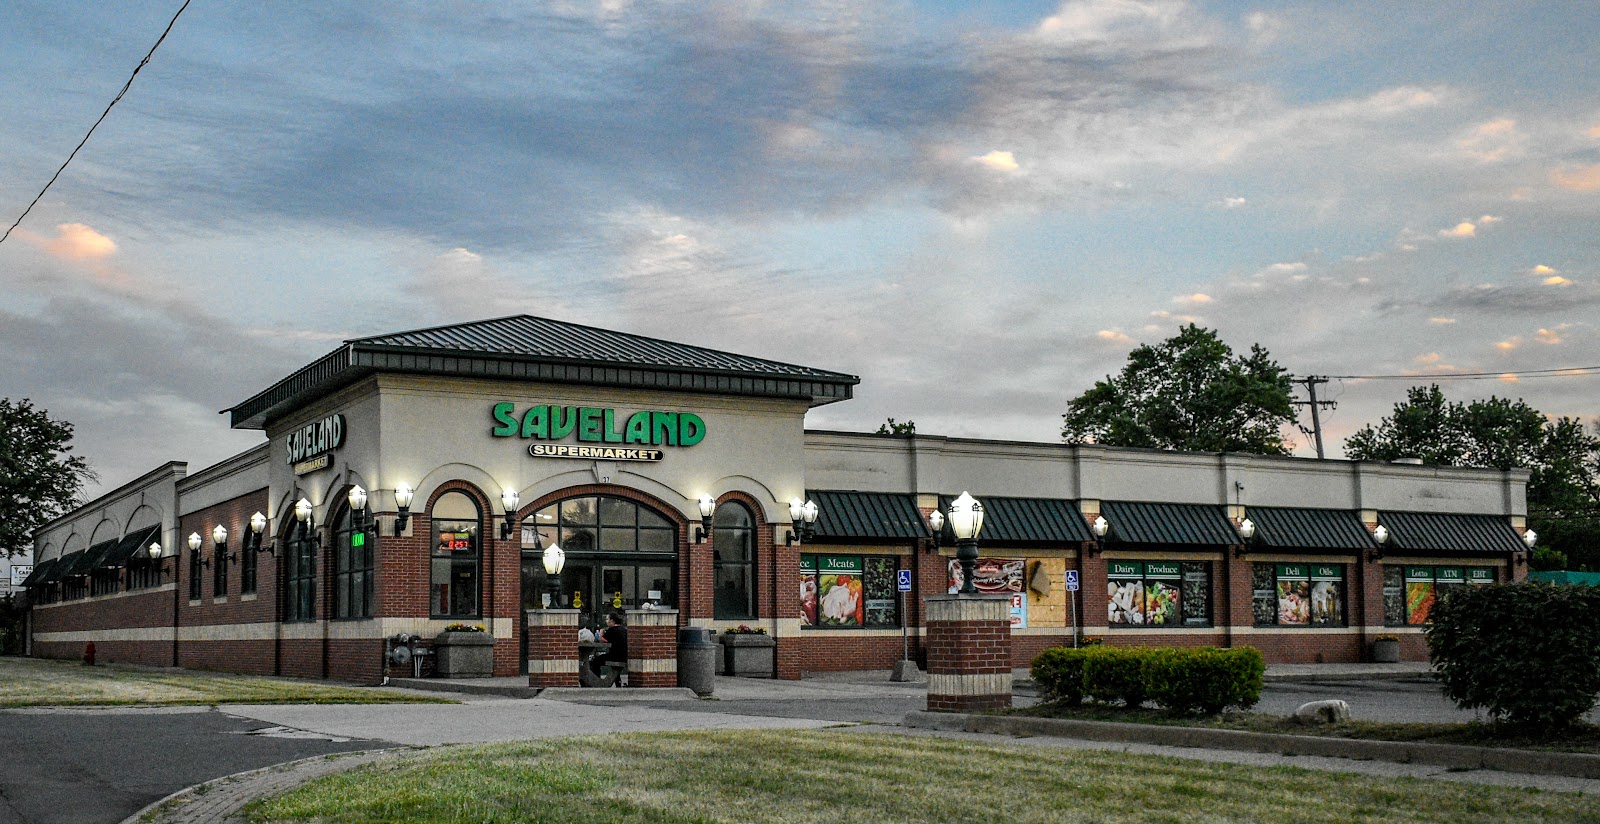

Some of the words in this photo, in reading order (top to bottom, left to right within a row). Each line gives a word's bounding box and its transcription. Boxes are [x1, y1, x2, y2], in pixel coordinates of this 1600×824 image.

[491, 401, 707, 447] SAVELAND
[286, 413, 343, 465] SAVELAND
[533, 444, 659, 460] SUPERMARKET
[827, 558, 855, 568] Meats
[1114, 564, 1136, 575] Dairy
[1148, 564, 1178, 574] Produce
[1285, 567, 1300, 576] Deli
[1318, 567, 1334, 576] Oils
[1411, 569, 1429, 577] Lotto
[1472, 570, 1487, 578] EBT
